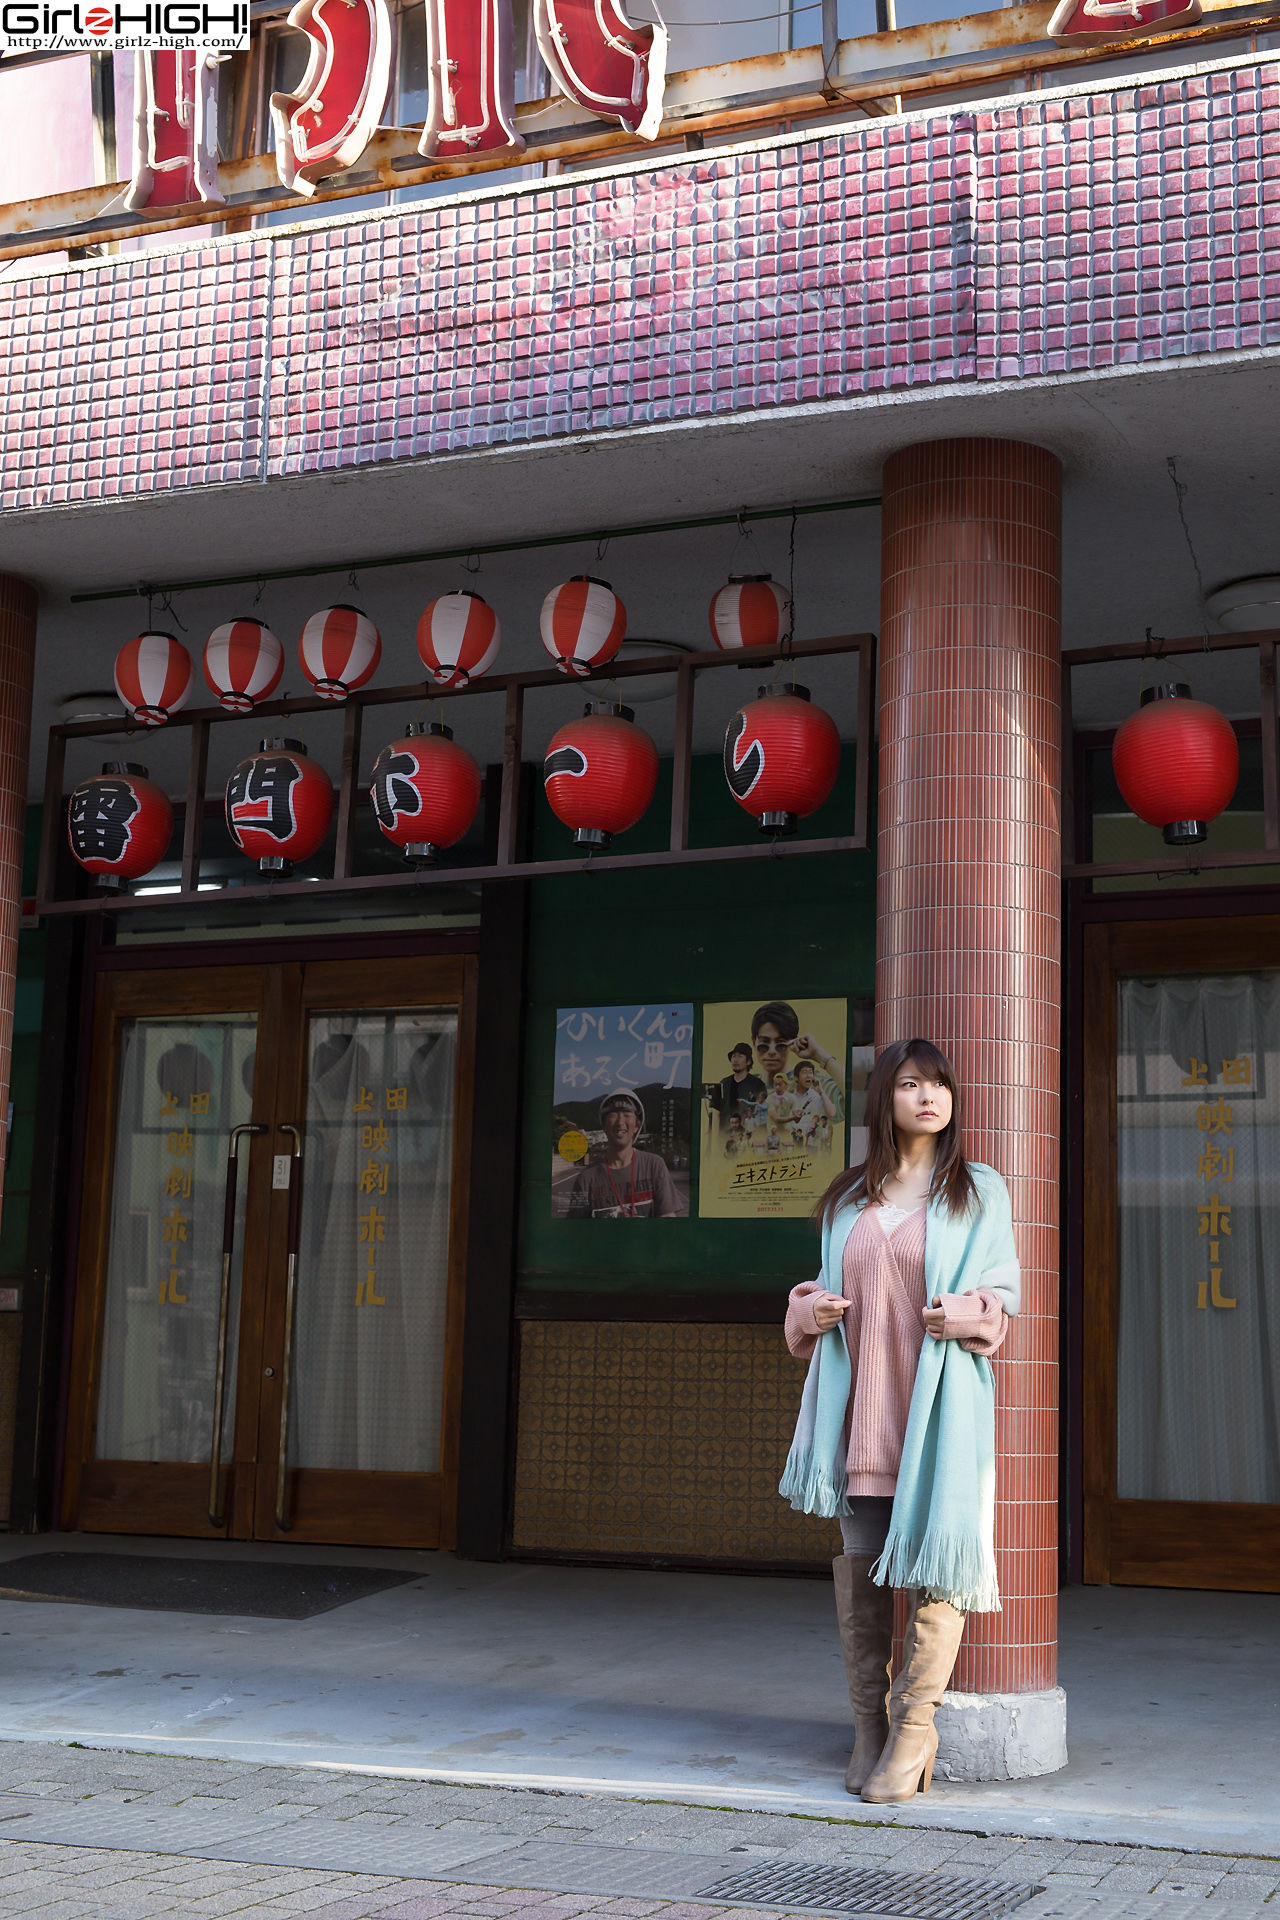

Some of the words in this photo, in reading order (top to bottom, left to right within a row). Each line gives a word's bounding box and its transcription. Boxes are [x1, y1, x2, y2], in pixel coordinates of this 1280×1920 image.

[225, 757, 303, 848] 門
[556, 1007, 693, 1043] ひいくんの
[560, 1041, 691, 1089] あるく町
[1181, 1057, 1251, 1087] 上田
[159, 1091, 211, 1116] 上田
[352, 1086, 408, 1113] 上田
[732, 1162, 813, 1185] エキストランド
[158, 1124, 195, 1305] 映劇ホール
[355, 1118, 390, 1306] 映劇ホール
[1196, 1096, 1237, 1309] 映劇ホール
